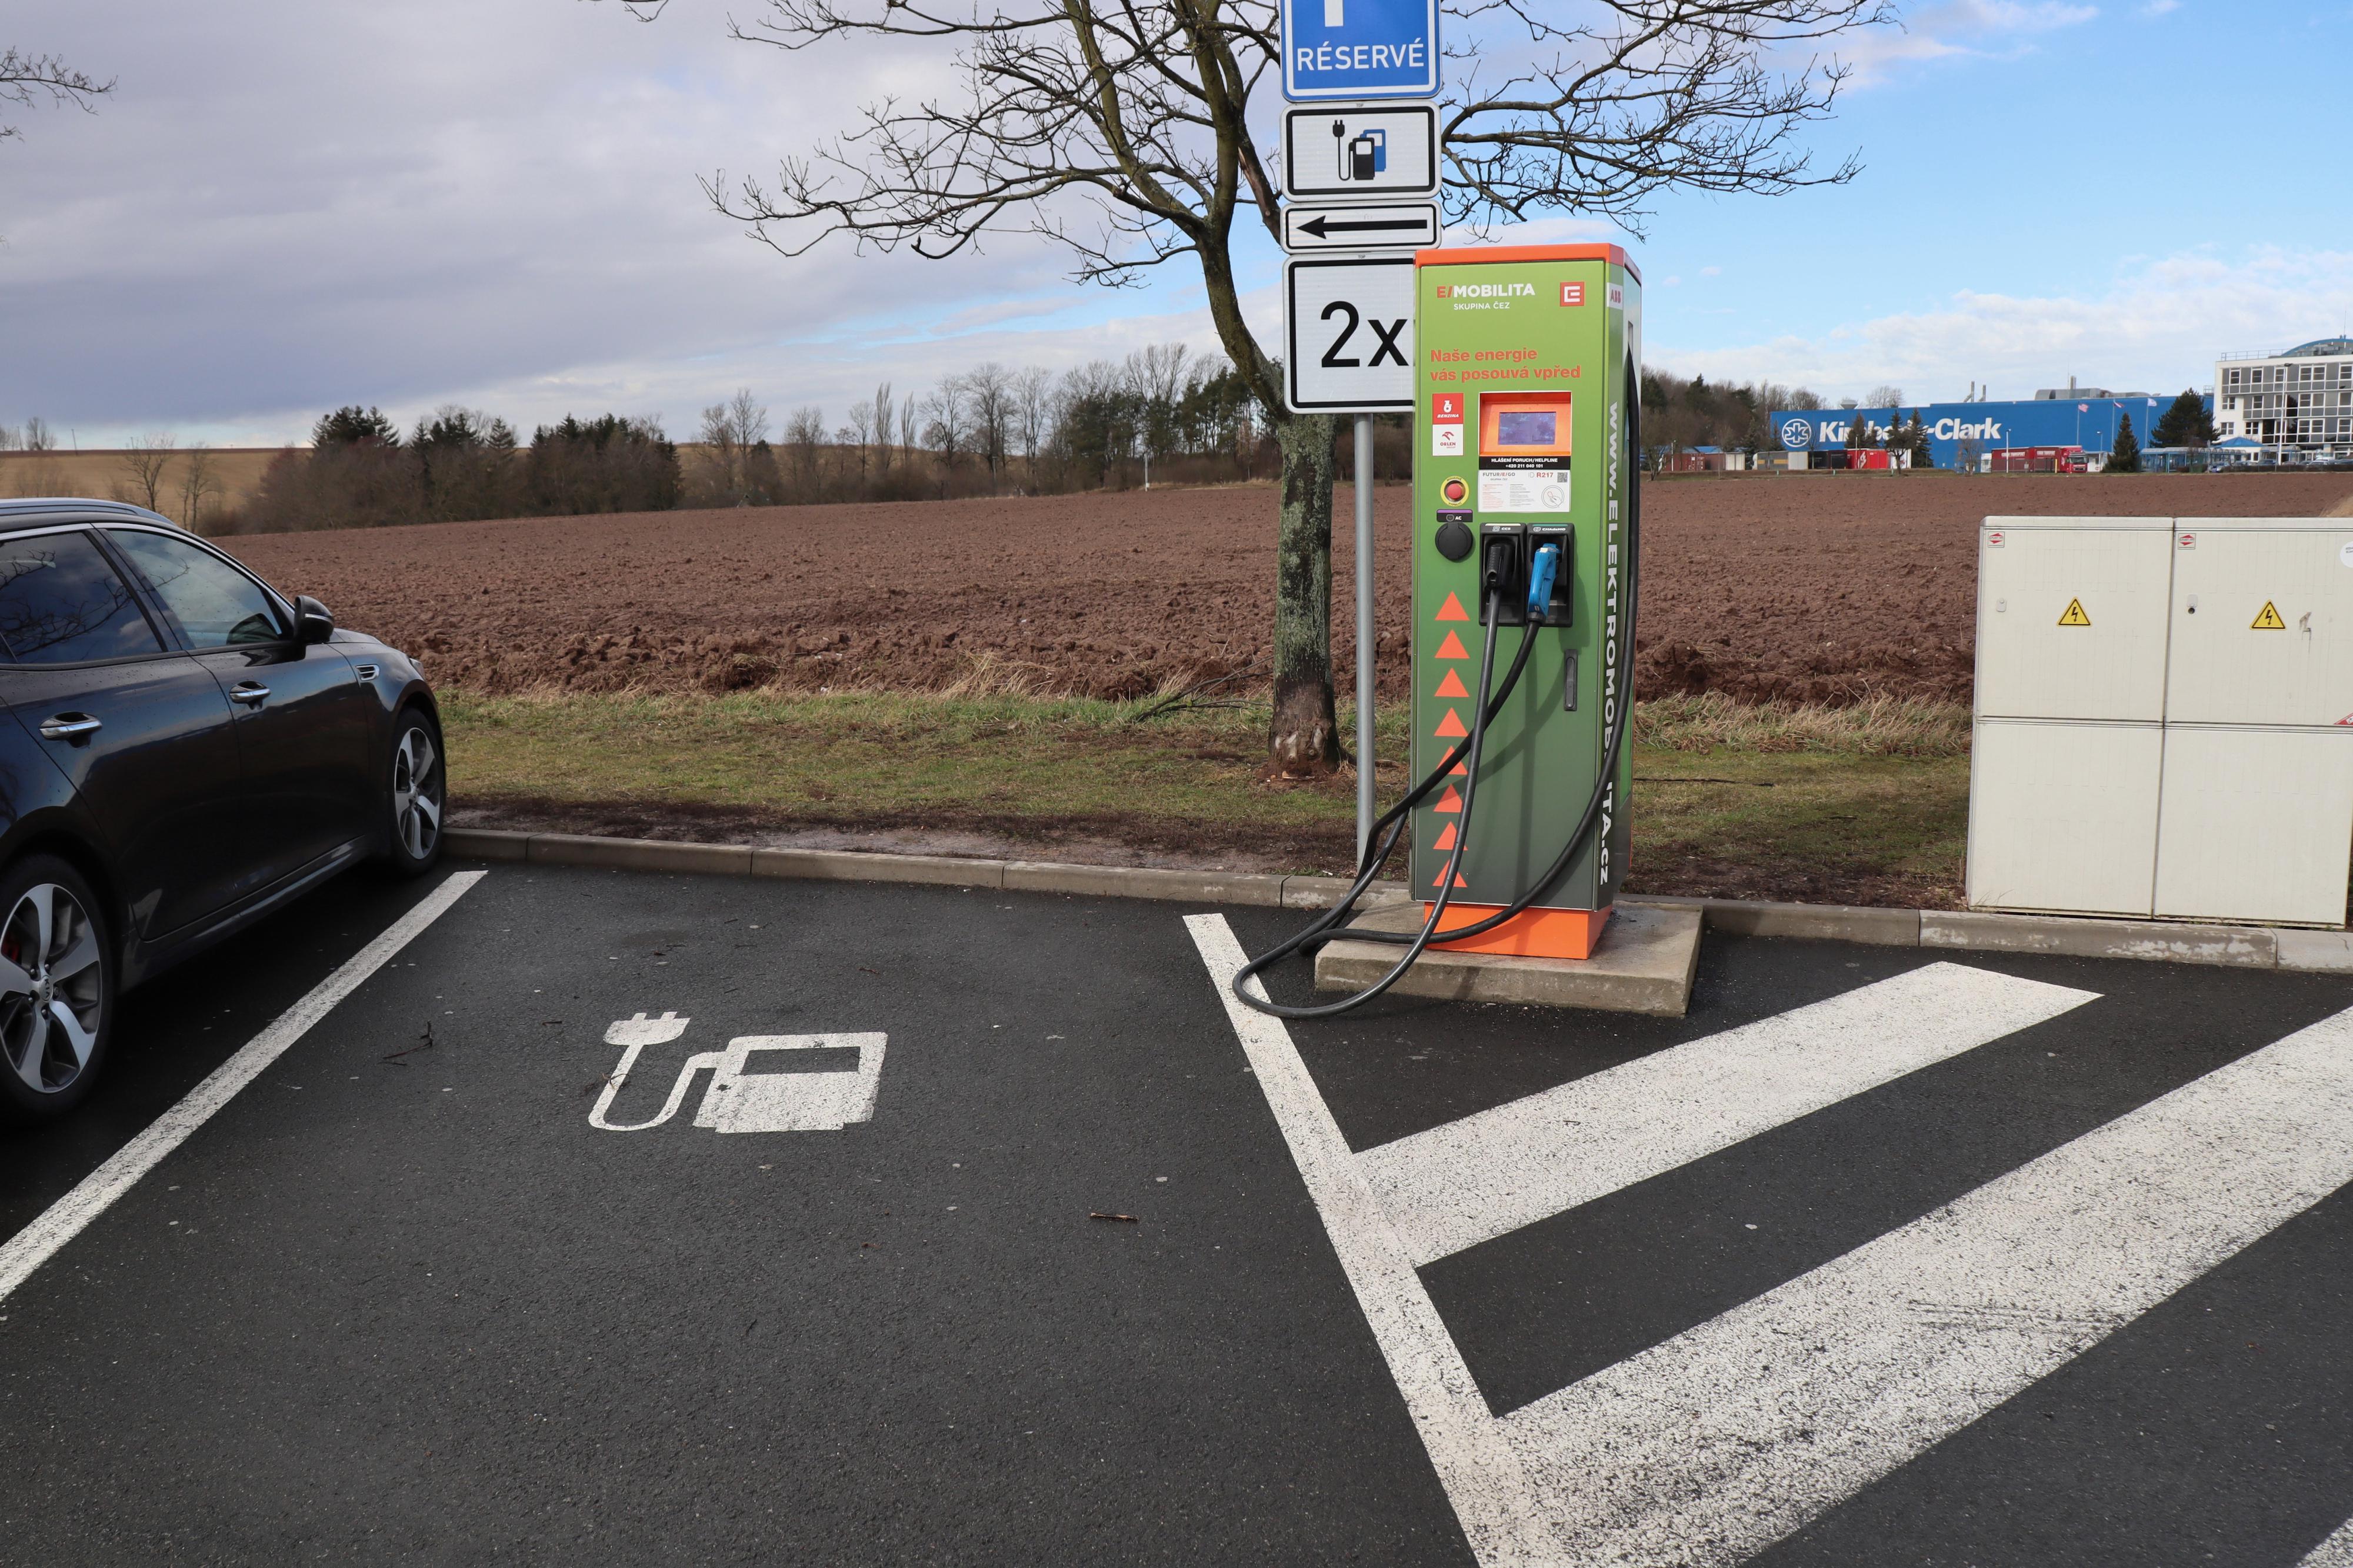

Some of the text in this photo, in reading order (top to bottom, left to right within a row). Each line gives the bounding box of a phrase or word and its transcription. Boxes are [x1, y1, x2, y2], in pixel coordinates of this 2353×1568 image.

[1297, 38, 1424, 71] RÉSERVÉ
[1437, 283, 1535, 298] E/MOBILITA
[1610, 289, 1621, 303] ABB
[1493, 301, 1510, 309] ČEZ
[1321, 301, 1409, 368] 2x
[1431, 348, 1537, 363] Naše energie
[1430, 365, 1581, 382] vás posouvá vpřed
[1819, 418, 2002, 443] Kib-Clark
[1600, 401, 1618, 885] WWW.ELEKTROMOBTA.CZ
